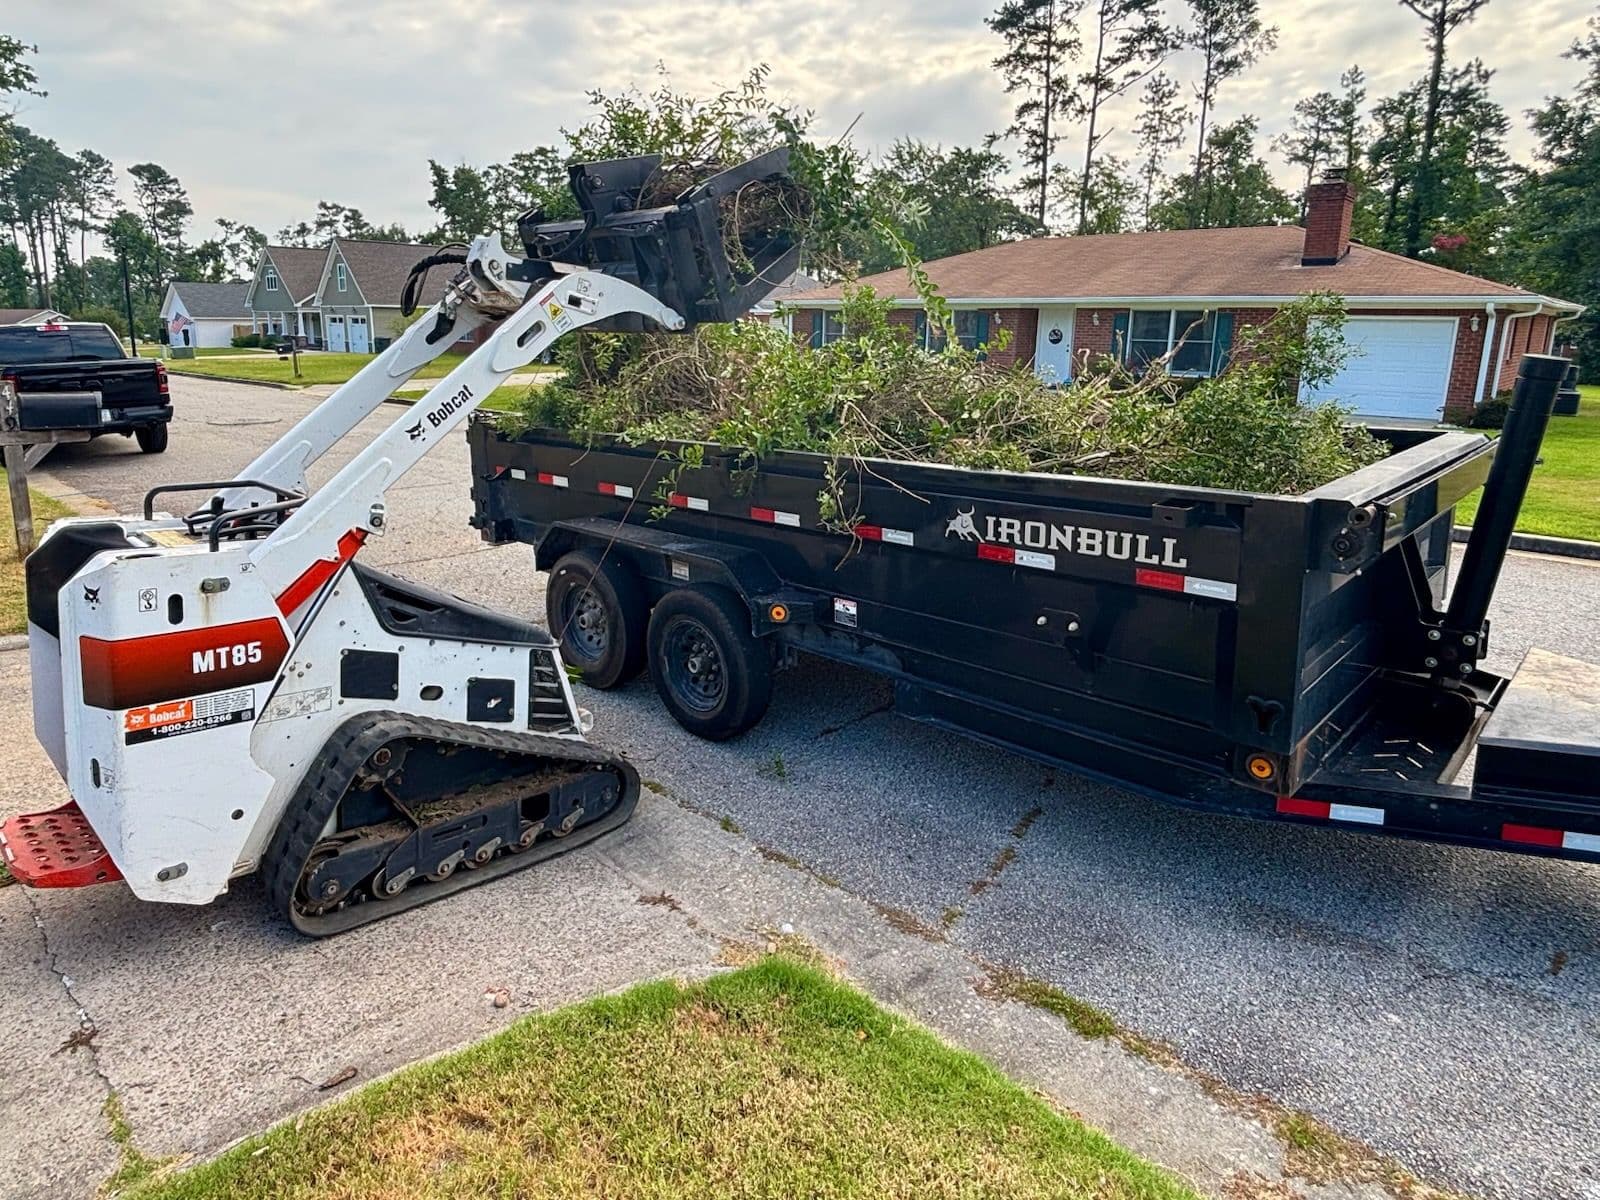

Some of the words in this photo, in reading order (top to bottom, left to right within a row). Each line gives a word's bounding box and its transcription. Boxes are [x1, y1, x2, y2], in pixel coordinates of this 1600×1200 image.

[426, 384, 474, 429] Bobcat
[985, 515, 1187, 568] IRONBULL
[192, 641, 262, 674] MT85
[149, 708, 186, 724] Bobcat
[151, 713, 232, 735] 1-800-220-6266
